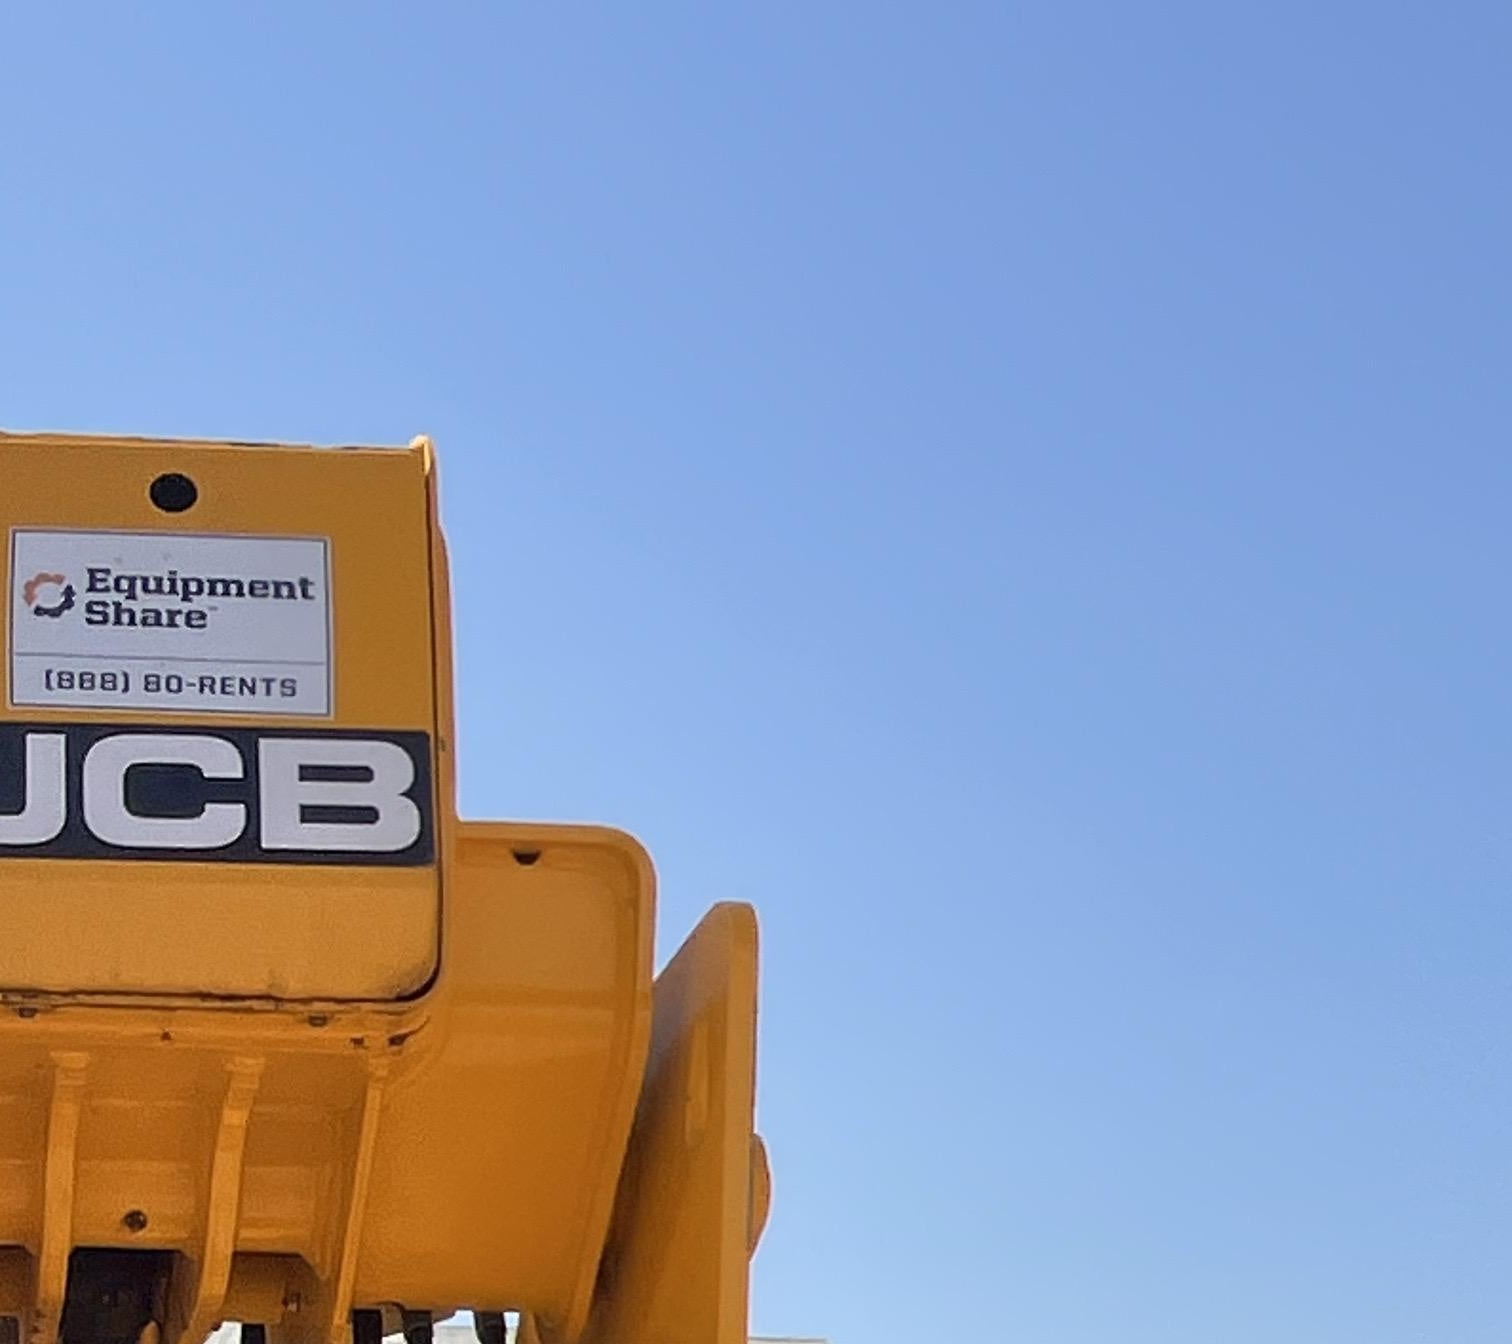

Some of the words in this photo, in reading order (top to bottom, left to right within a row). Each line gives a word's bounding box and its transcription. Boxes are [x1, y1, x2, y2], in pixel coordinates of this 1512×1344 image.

[86, 568, 315, 602] Equipment
[85, 600, 208, 628] Share
[45, 669, 130, 693] (888)
[143, 673, 297, 697] 80-RENTS
